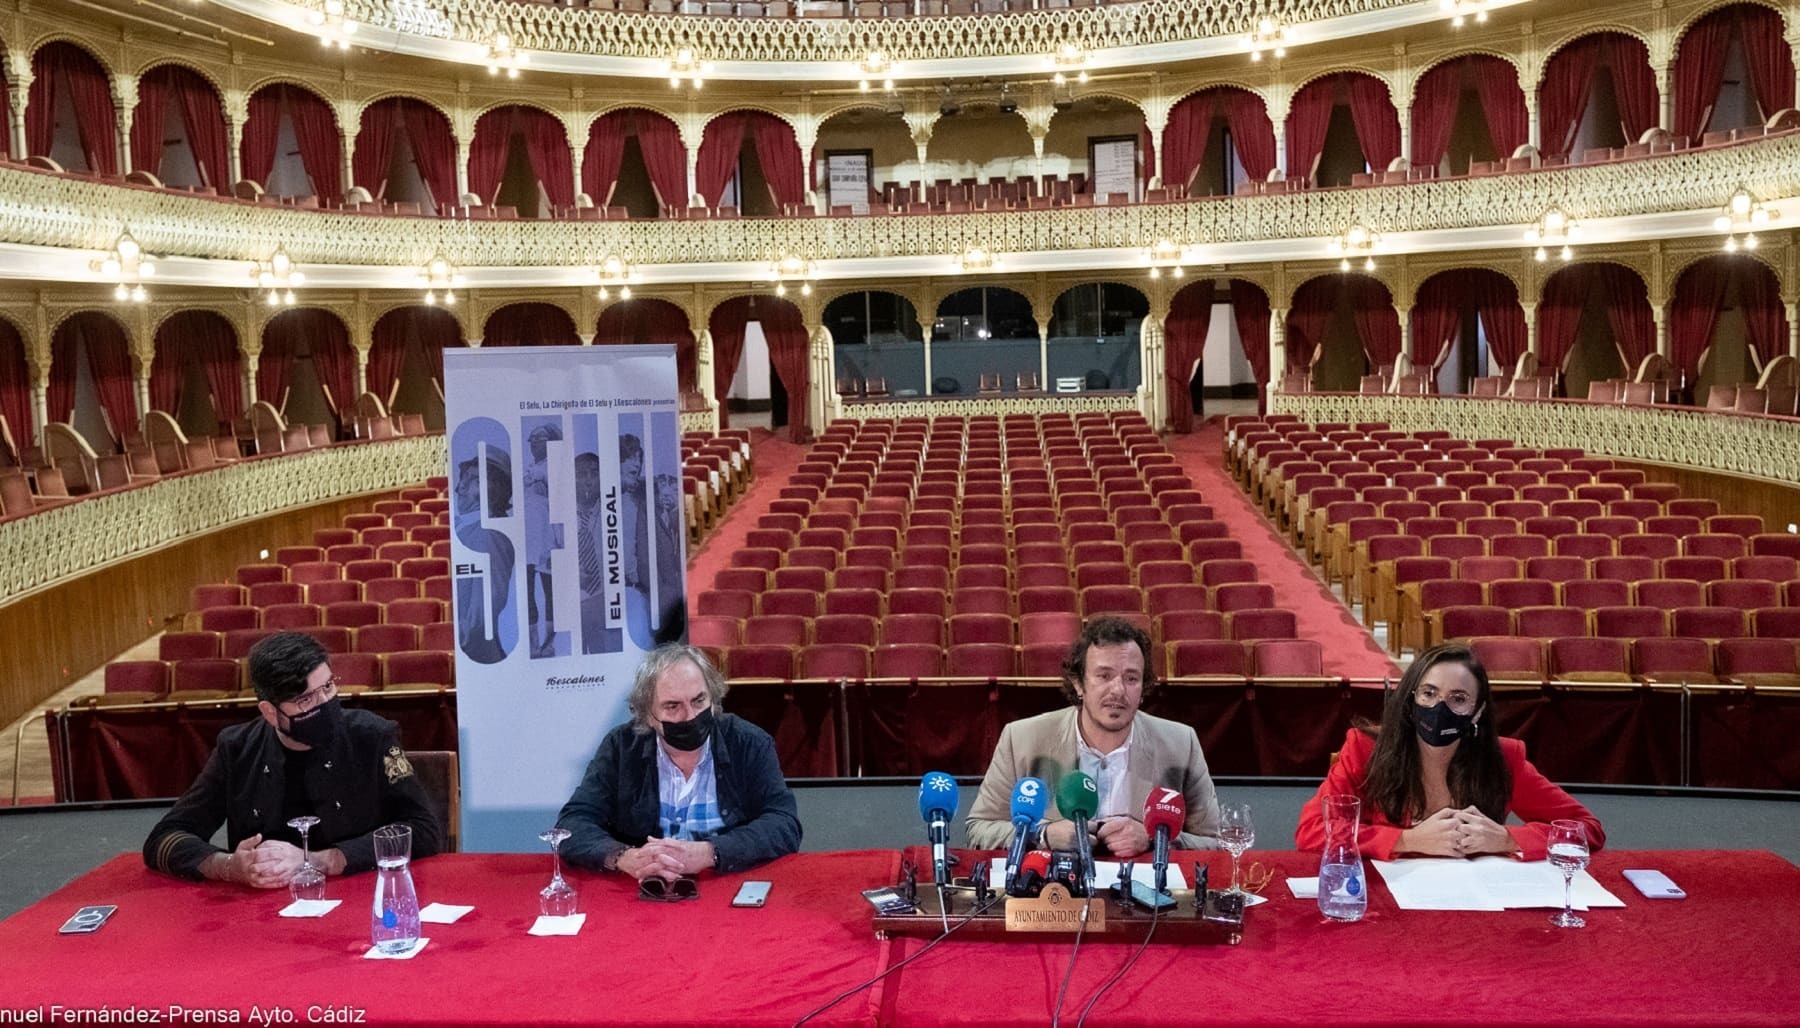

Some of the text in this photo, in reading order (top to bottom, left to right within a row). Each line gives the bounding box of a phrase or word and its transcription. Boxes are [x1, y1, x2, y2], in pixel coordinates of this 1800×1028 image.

[451, 412, 687, 665] SELU
[605, 485, 622, 620] EL MUSICAL
[455, 563, 484, 576] EL
[1159, 787, 1181, 804] 7
[1155, 803, 1181, 815] siete
[1014, 909, 1099, 922] AYUNTAMIENTO DE CDIZ
